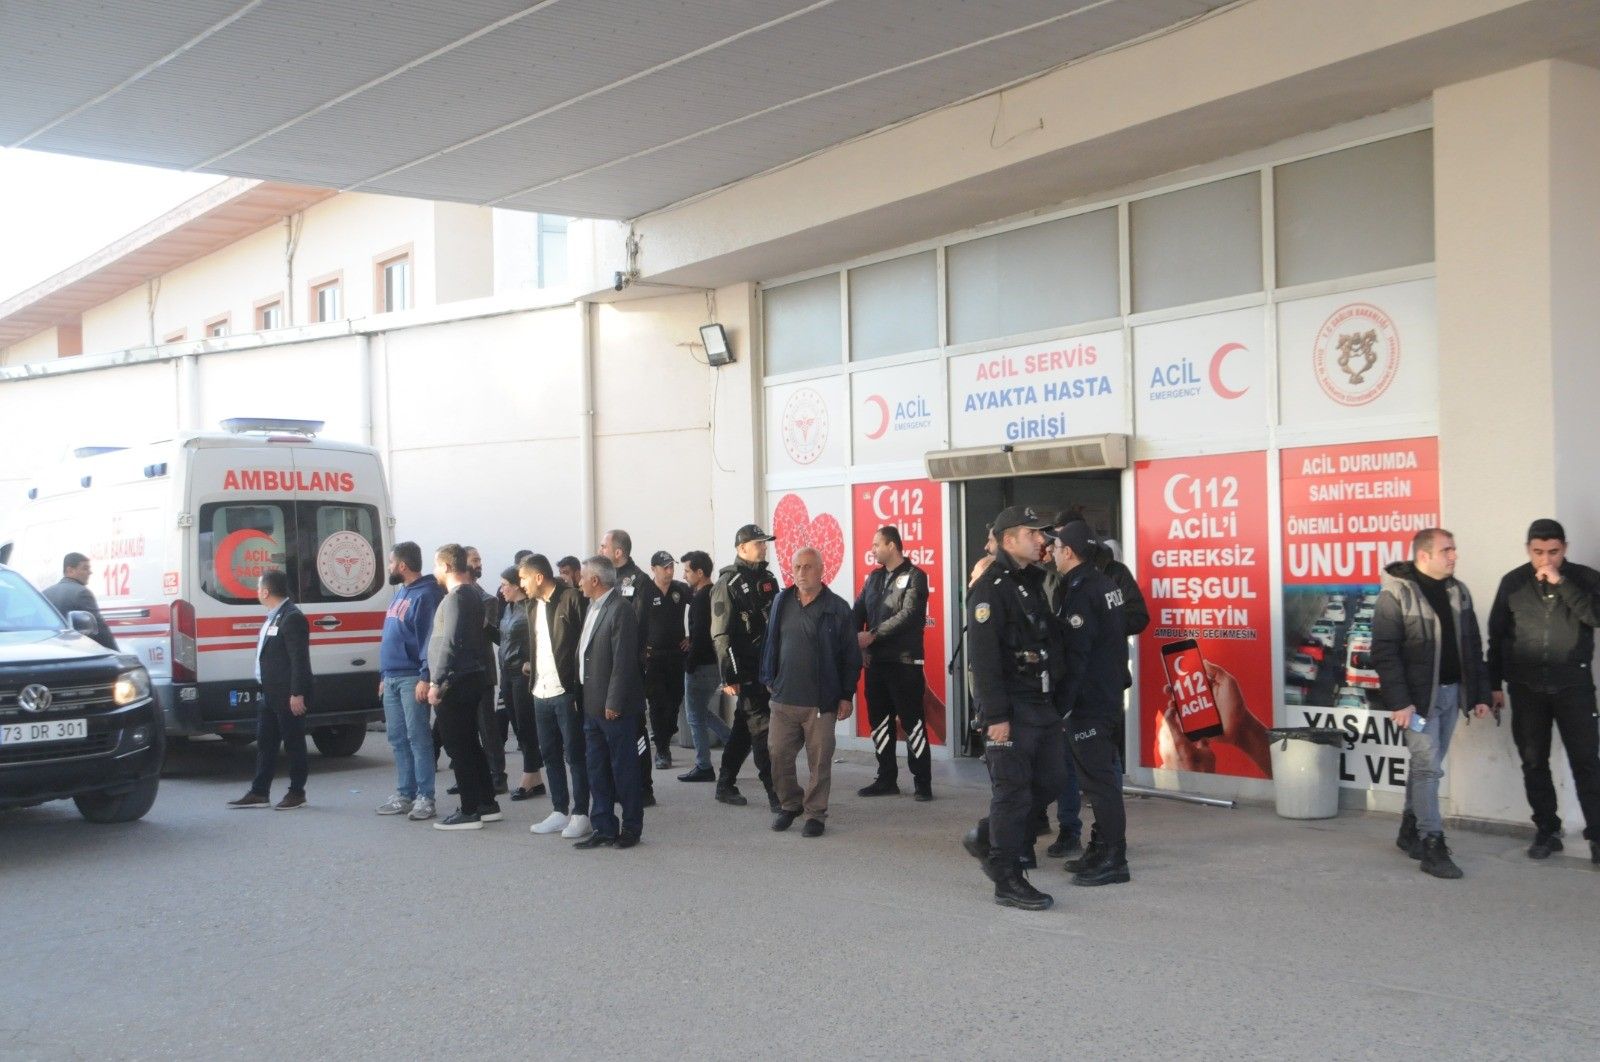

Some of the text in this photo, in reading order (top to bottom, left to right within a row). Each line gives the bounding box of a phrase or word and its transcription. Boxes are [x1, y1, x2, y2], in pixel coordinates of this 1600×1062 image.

[976, 344, 1097, 381] ACİL SERVİS
[1150, 357, 1201, 388] ACİL
[965, 375, 1112, 412] AYAKTA HASTA
[1150, 387, 1201, 401] EMERGENCY
[895, 395, 931, 420] ACİL
[894, 421, 931, 431] EMERGENCY
[1006, 412, 1066, 440] GİRİŞİ
[1302, 451, 1417, 475] ACİL DURUMDA
[223, 470, 355, 492] AMBULANS
[1189, 476, 1239, 508] 112
[1309, 477, 1411, 502] SANİYELERİN
[890, 488, 924, 516] 112
[878, 518, 922, 541] İL'İ
[1168, 511, 1237, 540] ACİL'İ
[1287, 511, 1437, 535] ÖNEMLİ OLDUĞUNU
[1151, 544, 1256, 568] GEREKSİZ
[1288, 541, 1414, 577] UNUTM
[103, 563, 130, 596] 112
[1151, 576, 1257, 604] MEŞGUL
[1161, 605, 1248, 626] ETMEYİN
[1154, 628, 1200, 638] AMBULANS
[238, 691, 250, 702] 73
[1174, 671, 1207, 700] 112
[1182, 695, 1214, 717] ACİL
[3, 722, 83, 741] 73 DR 301
